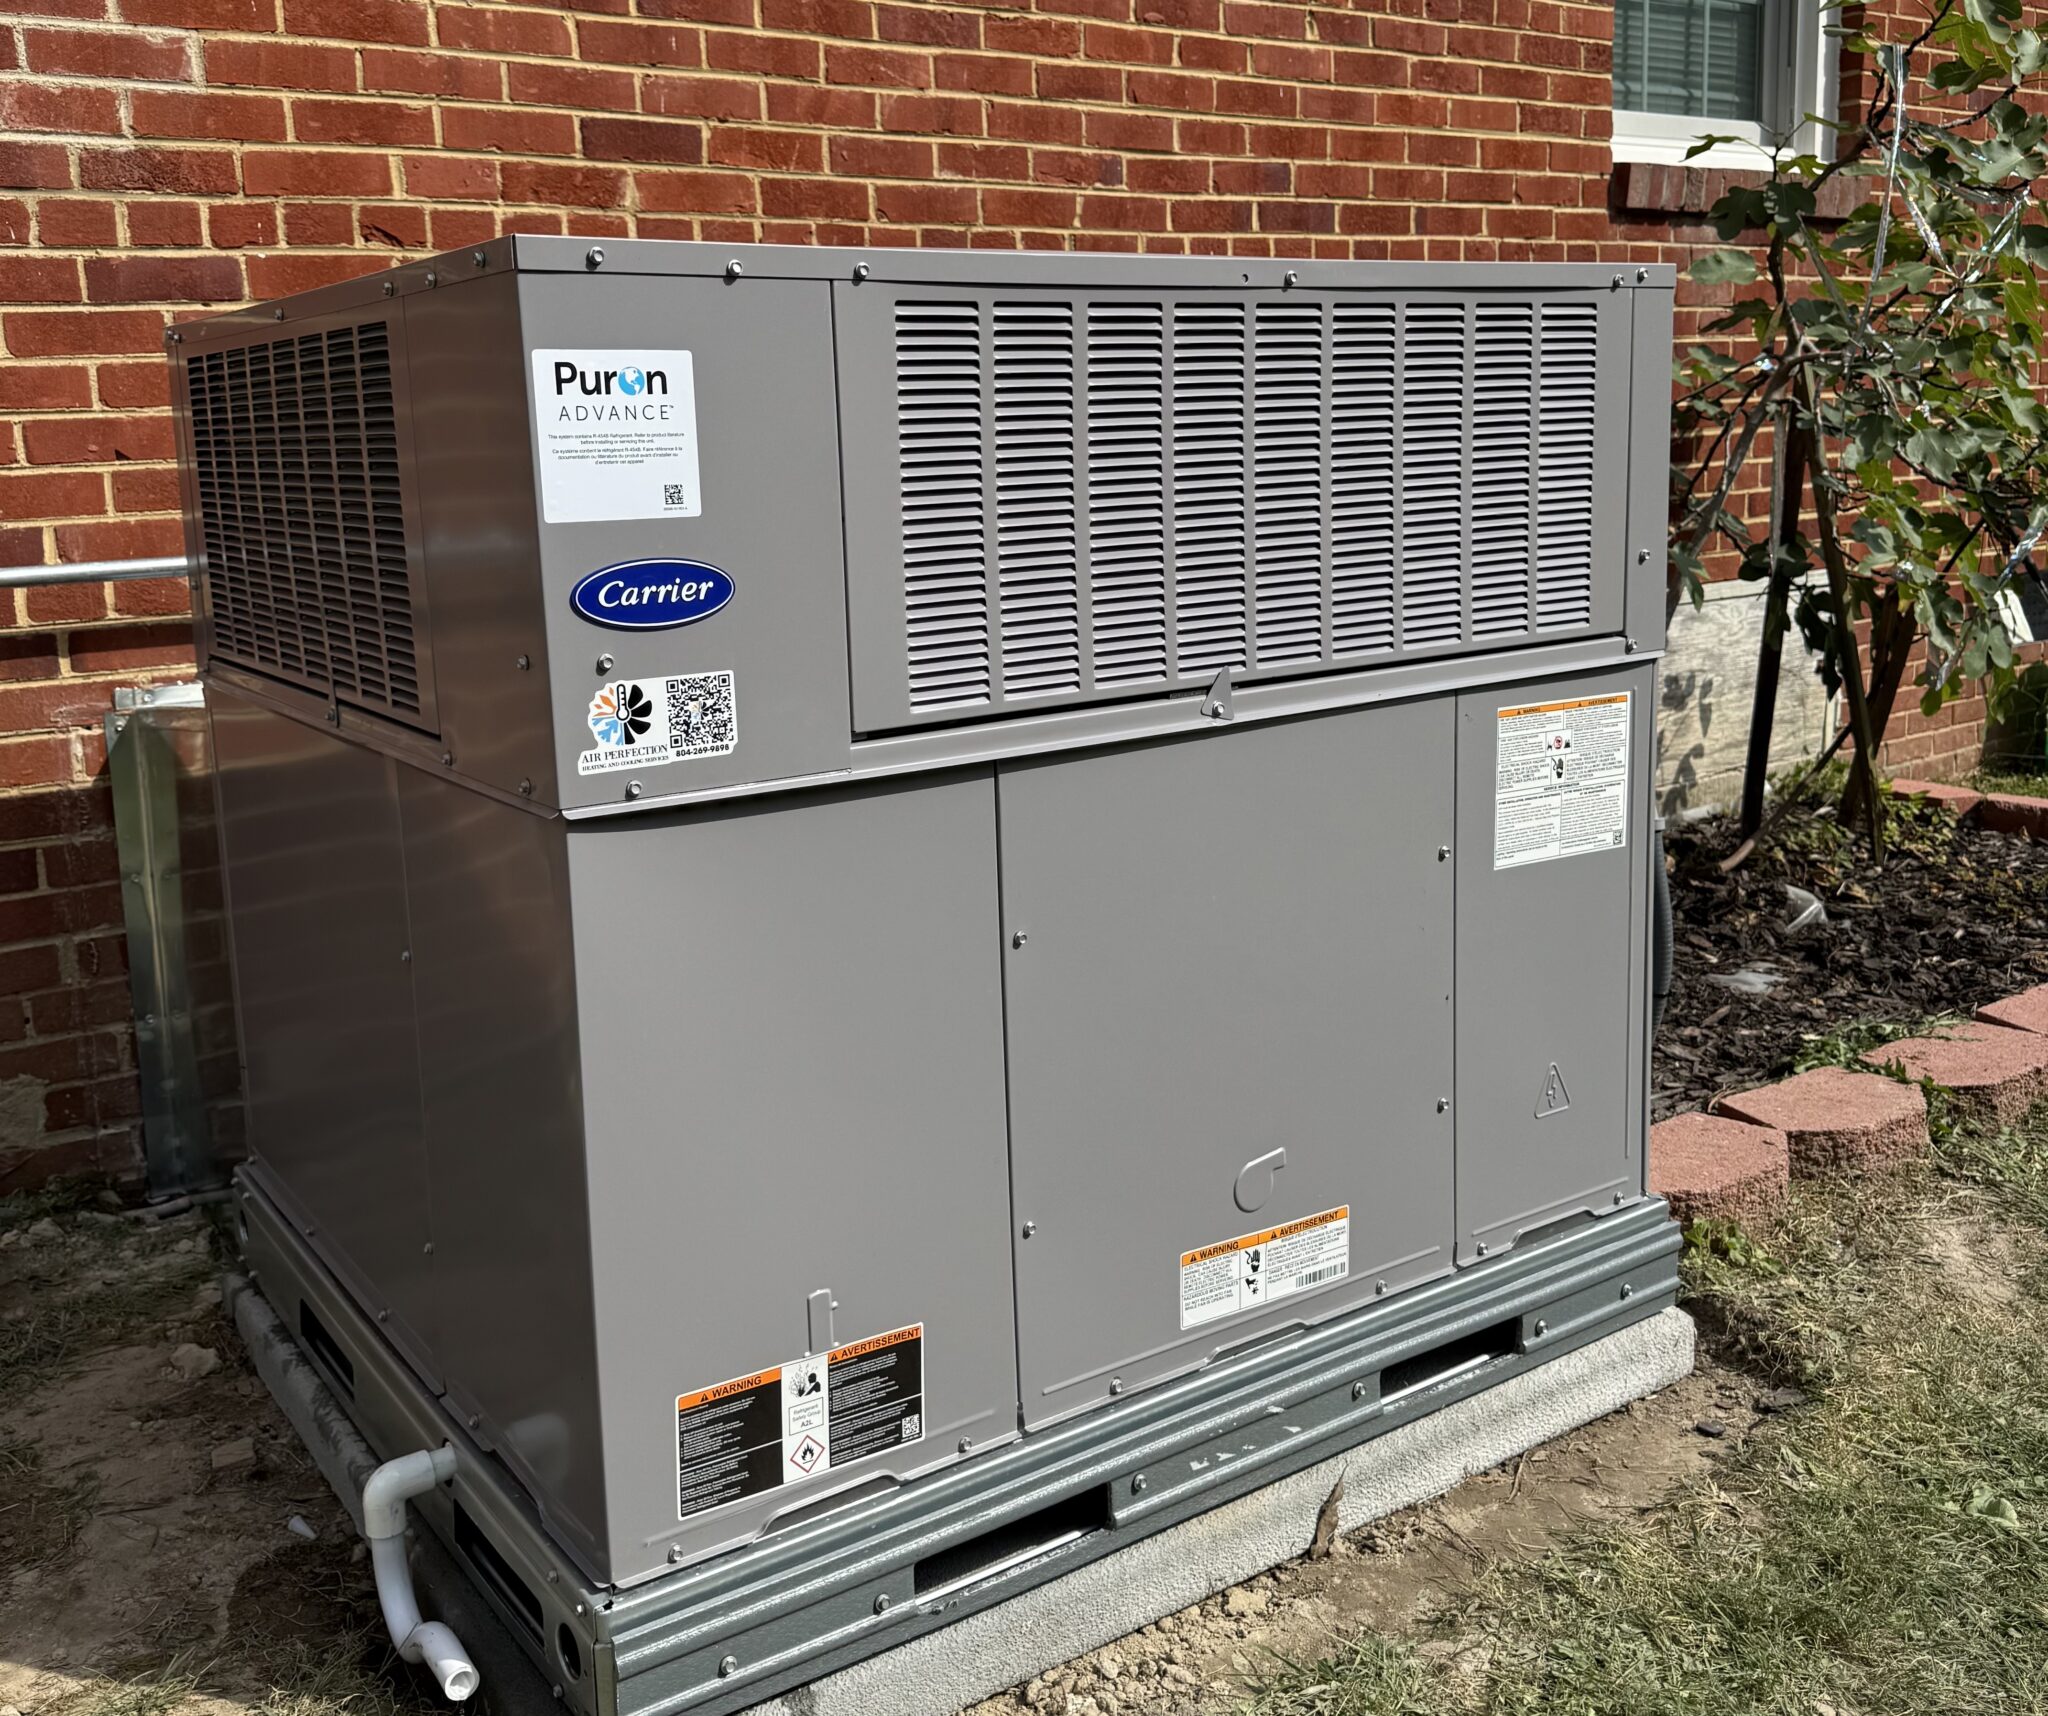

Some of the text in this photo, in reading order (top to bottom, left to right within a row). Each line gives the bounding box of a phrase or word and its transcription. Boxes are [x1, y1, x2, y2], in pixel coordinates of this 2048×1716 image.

[554, 362, 667, 396] Puron
[598, 577, 714, 608] Carrier
[582, 744, 668, 763] AIR PERFECTION
[676, 744, 729, 757] 804-269-9898
[582, 763, 606, 771] HEATING
[1280, 1211, 1339, 1236] AVERTISSEMENT
[1200, 1241, 1239, 1259] WARNING
[841, 1328, 920, 1359] AVERTISSEMENT
[712, 1376, 762, 1399] WARNING
[792, 1414, 806, 1422] Safety
[793, 1404, 818, 1415] Refrigerant
[801, 1420, 813, 1428] A2L
